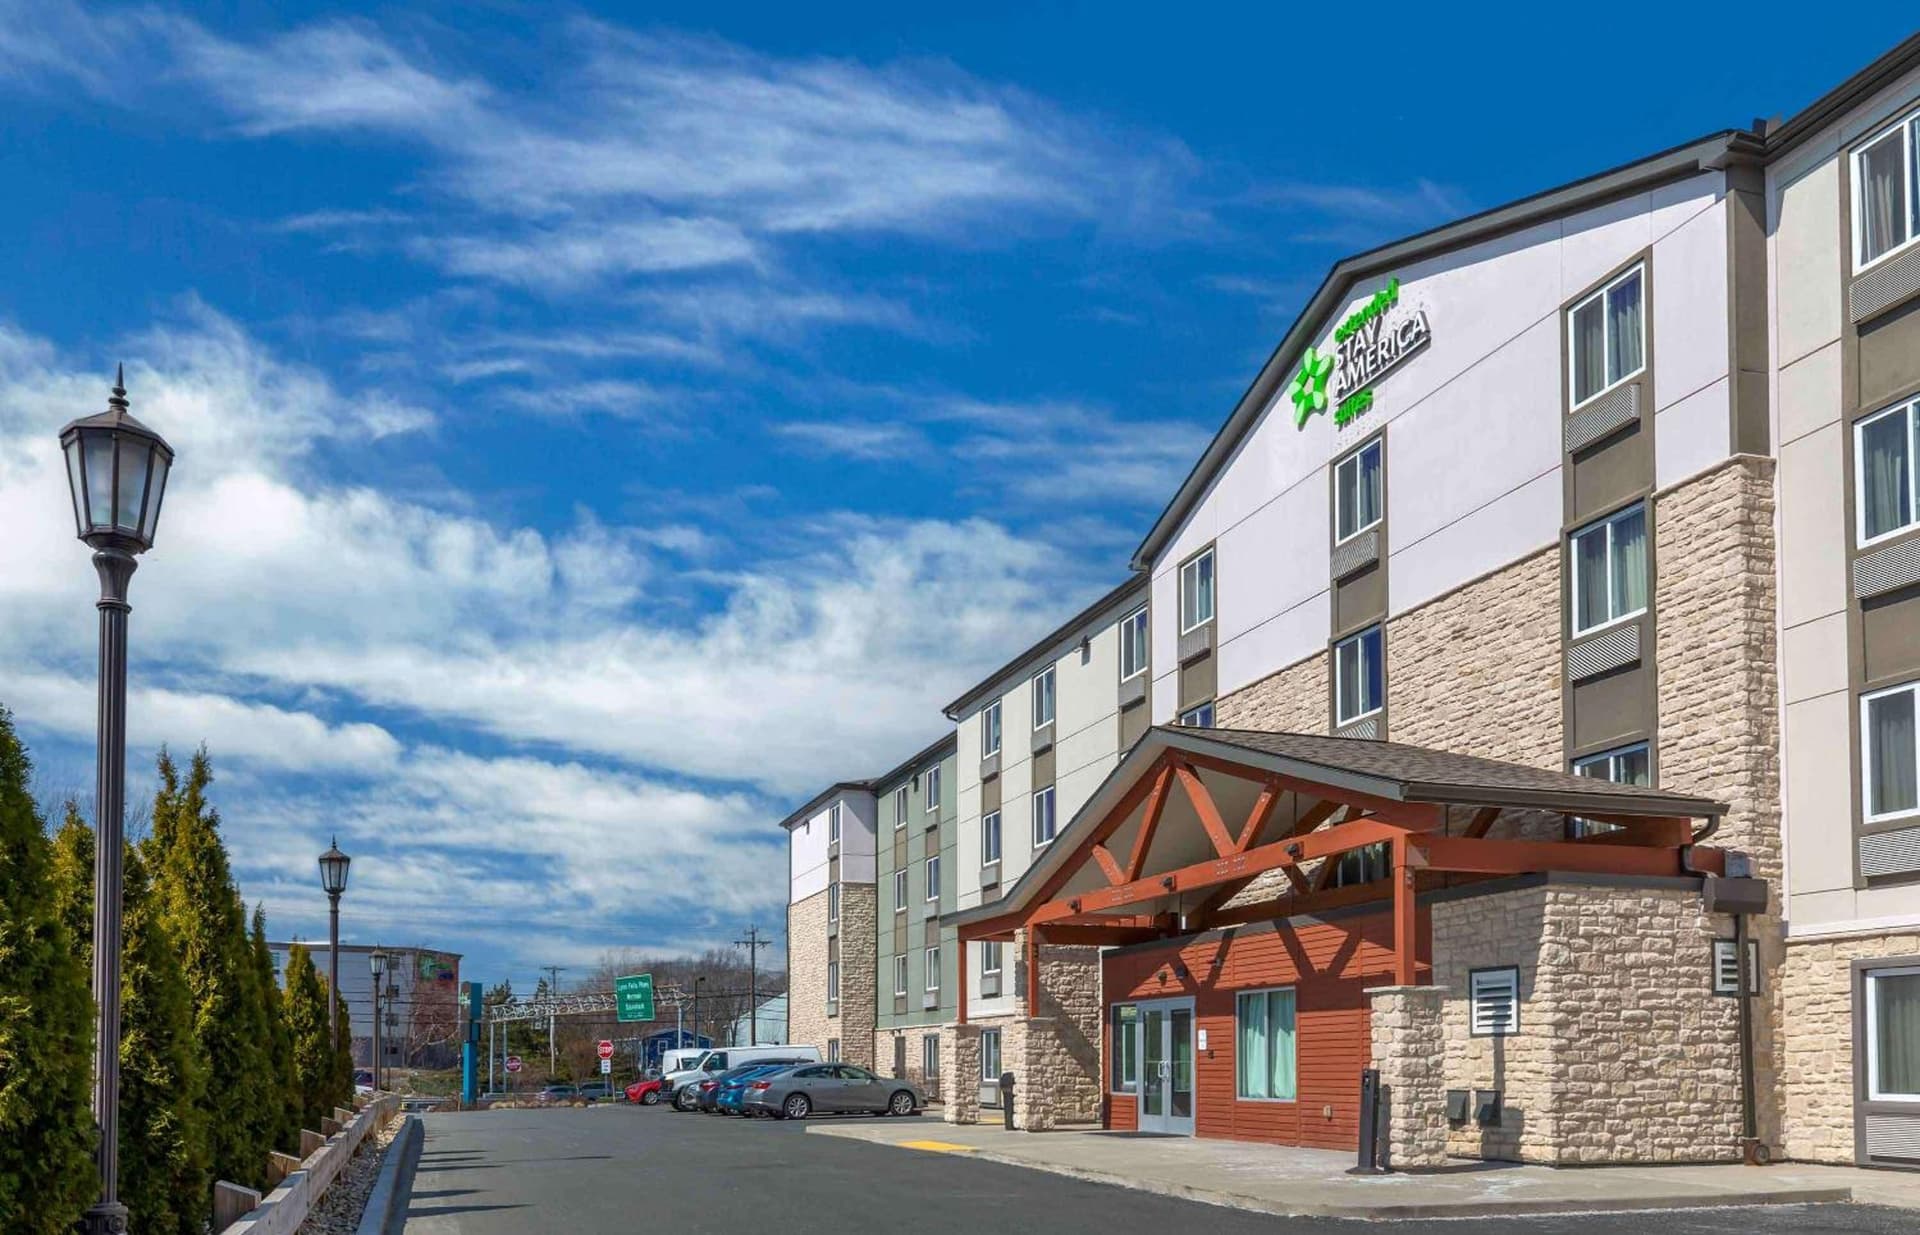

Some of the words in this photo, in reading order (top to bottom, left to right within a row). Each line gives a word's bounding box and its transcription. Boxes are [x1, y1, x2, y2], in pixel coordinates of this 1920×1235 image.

[1335, 316, 1383, 369] STAY
[1336, 311, 1428, 396] AMERICA
[599, 1046, 612, 1054] STOP
